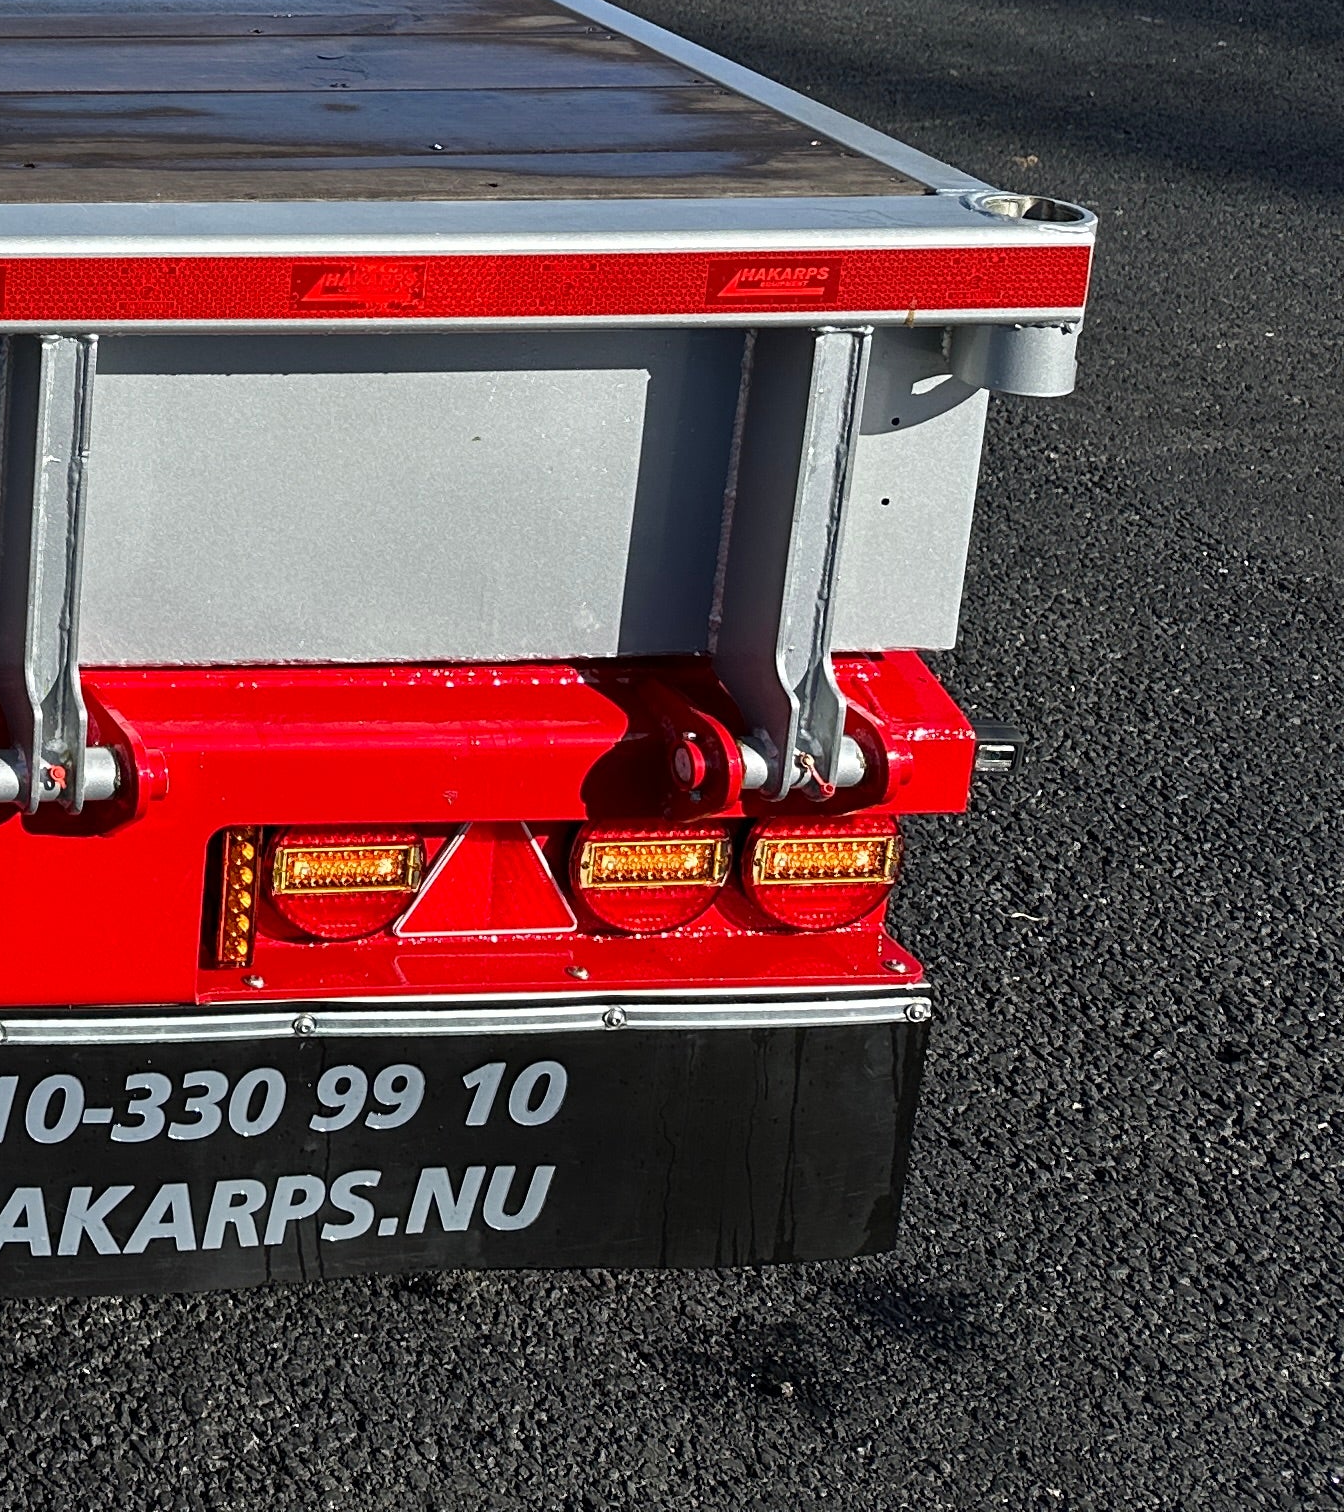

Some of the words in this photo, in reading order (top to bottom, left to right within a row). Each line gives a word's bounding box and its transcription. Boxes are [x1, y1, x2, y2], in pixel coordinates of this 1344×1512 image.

[740, 266, 830, 281] HAKARPS
[309, 1063, 426, 1133] 99
[462, 1060, 568, 1126] 10
